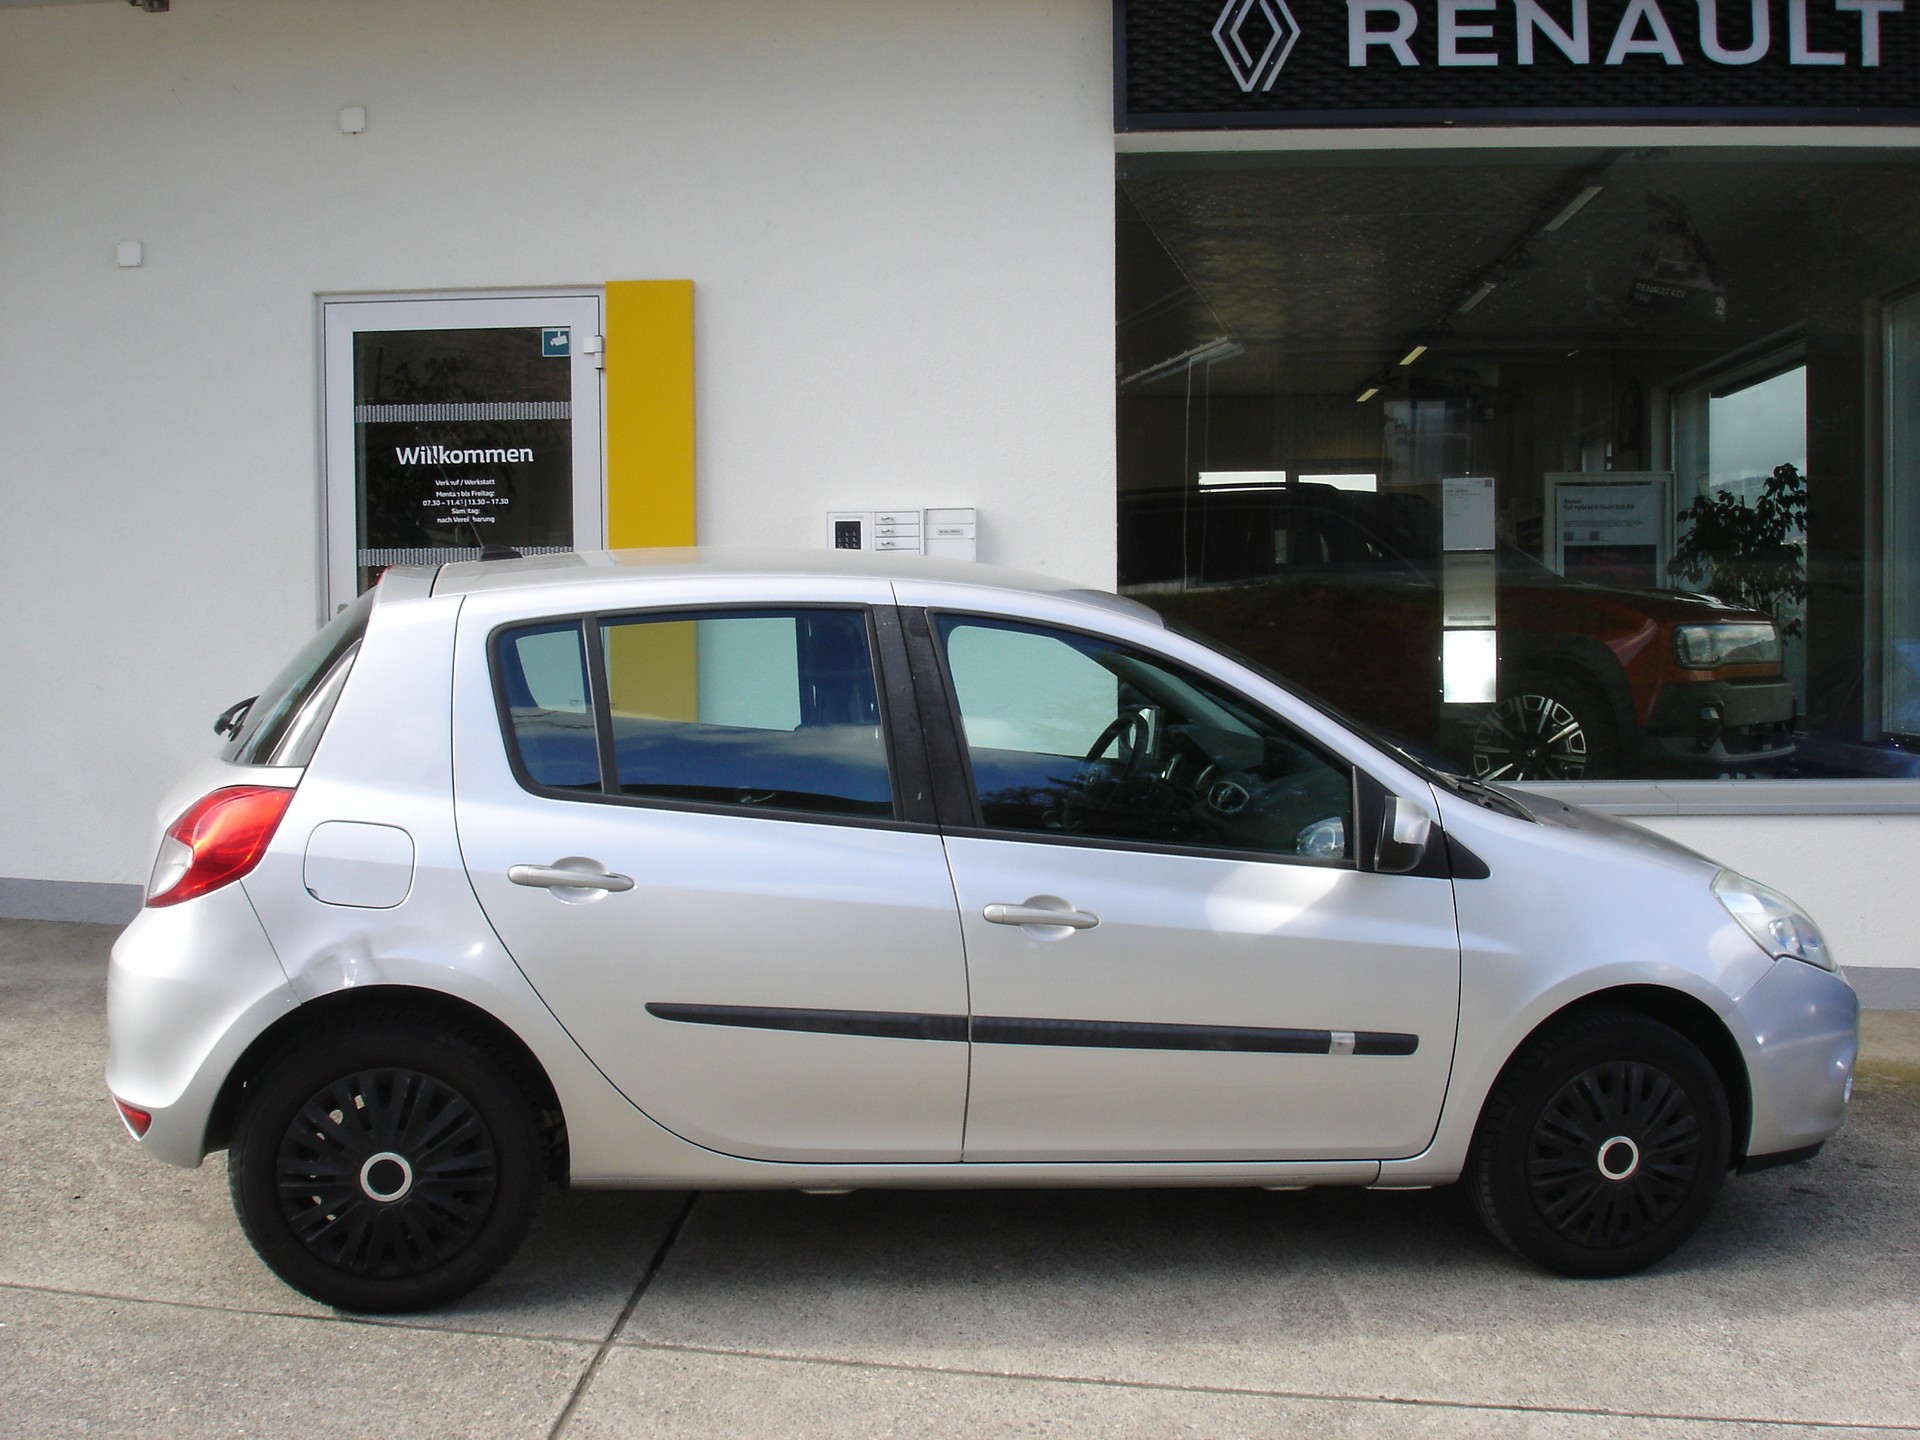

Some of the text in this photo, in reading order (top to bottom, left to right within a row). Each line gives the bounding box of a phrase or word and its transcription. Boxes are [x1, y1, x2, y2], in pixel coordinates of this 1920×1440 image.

[1346, 0, 1904, 68] RENAULT
[395, 445, 534, 465] Willkommen
[471, 490, 495, 498] Freitag:
[453, 516, 495, 524] Vereibarung
